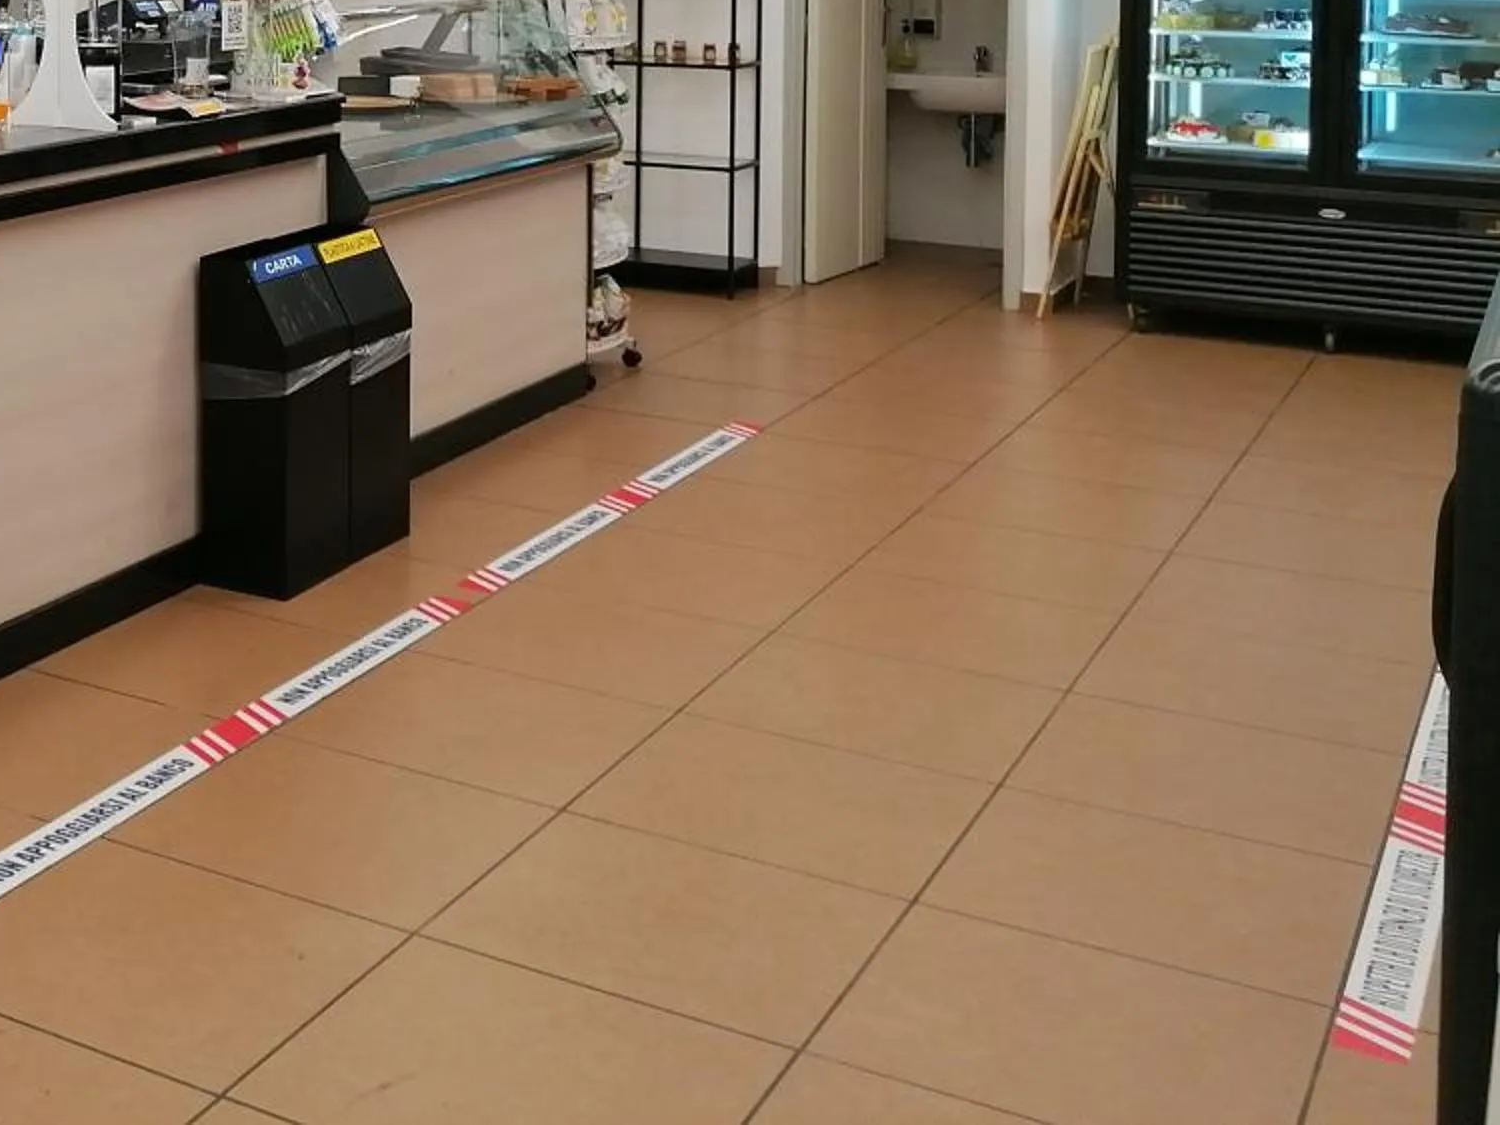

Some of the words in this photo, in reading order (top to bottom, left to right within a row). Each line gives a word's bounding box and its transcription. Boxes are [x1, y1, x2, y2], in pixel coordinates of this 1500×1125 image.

[264, 254, 302, 274] CARTA
[15, 798, 125, 864] APPOGGIARSI
[117, 787, 149, 803] AL
[135, 758, 195, 791] BANCO
